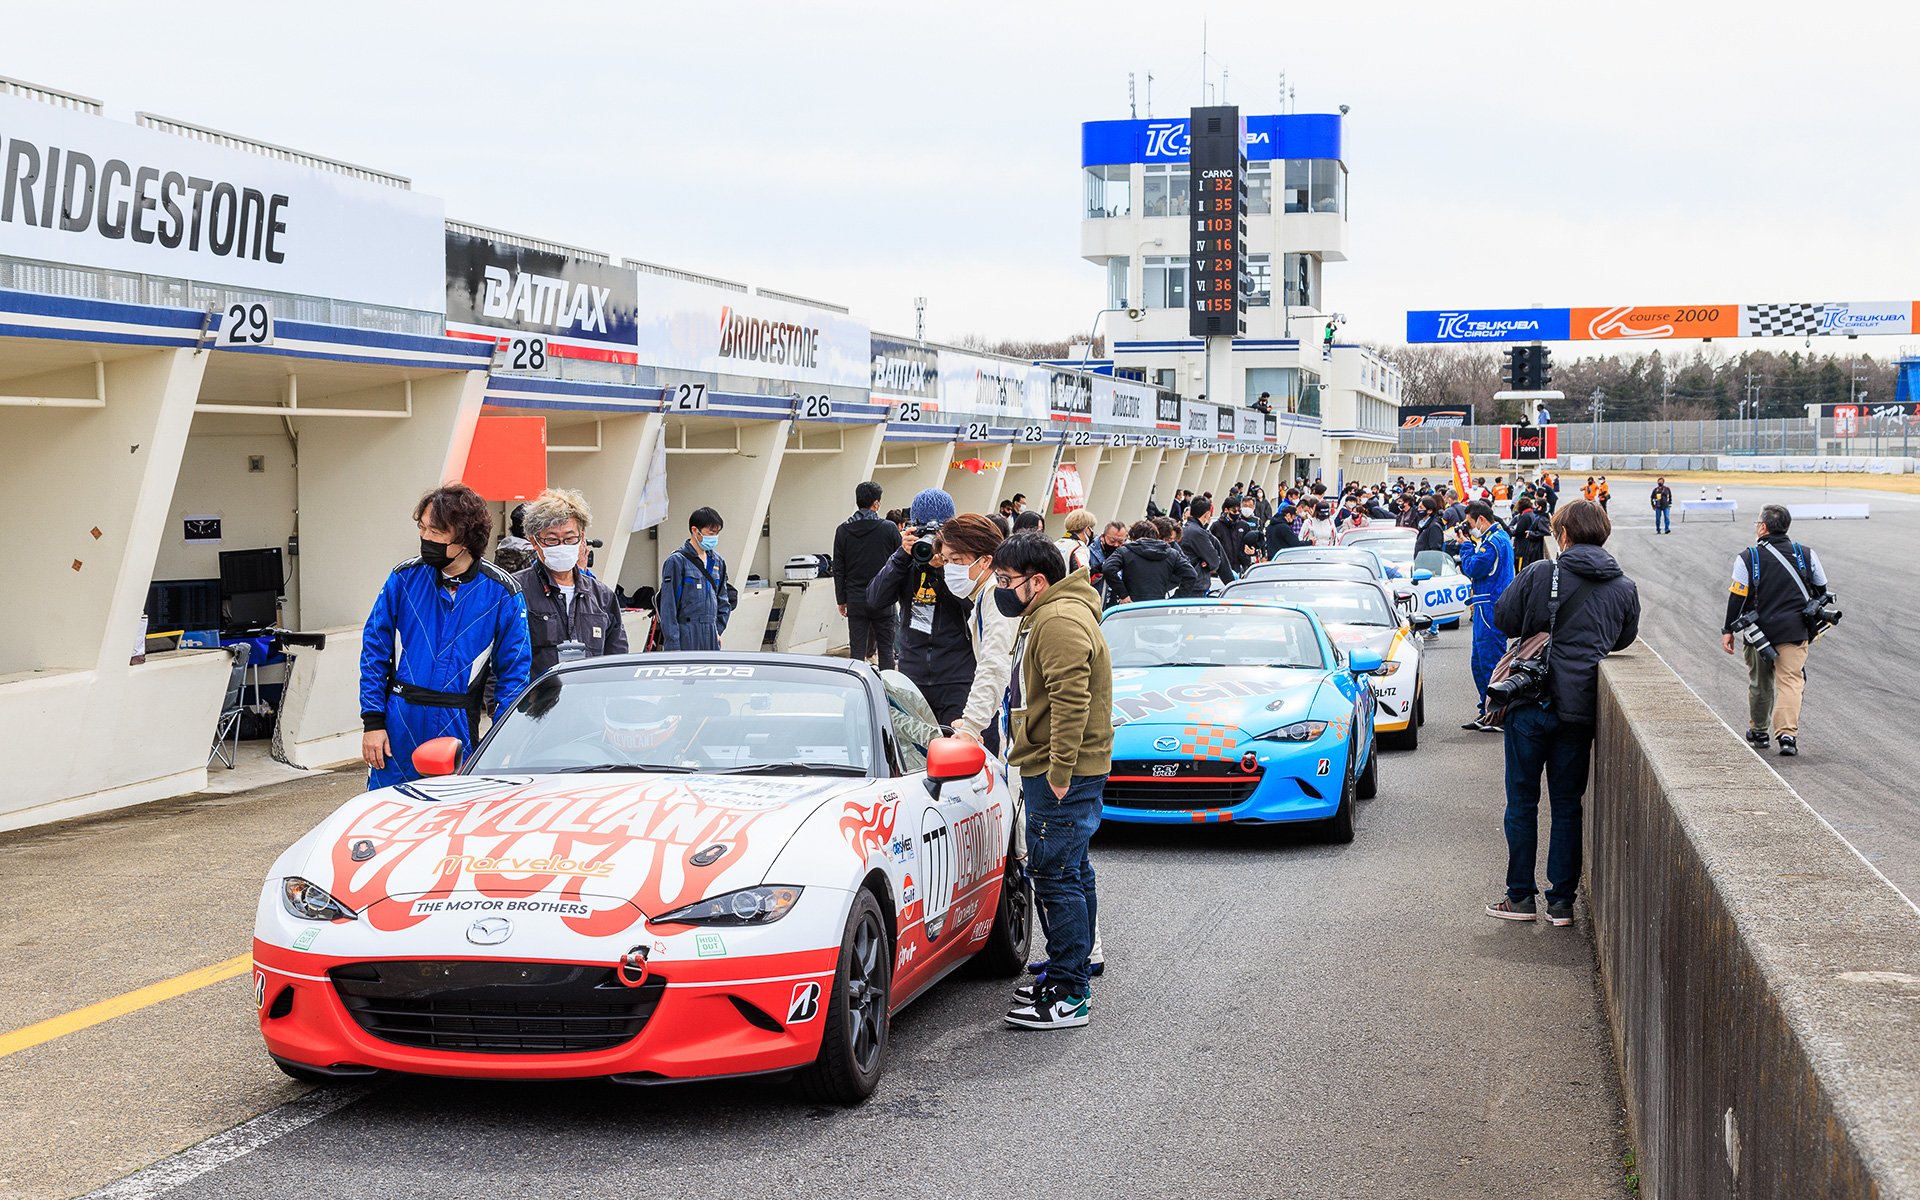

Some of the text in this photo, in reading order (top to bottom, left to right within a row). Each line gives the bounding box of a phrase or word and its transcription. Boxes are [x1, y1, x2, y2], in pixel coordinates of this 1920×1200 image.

[1202, 170, 1219, 178] CAR
[1216, 178, 1232, 191] 32
[0, 137, 290, 265] RIDGESTONE
[1216, 198, 1232, 211] 35
[1208, 218, 1232, 232] 103
[1216, 238, 1232, 251] 16
[1215, 258, 1232, 271] 29
[1215, 278, 1232, 291] 36
[482, 264, 611, 334] BATTLAX
[1208, 298, 1232, 312] 155
[1630, 308, 1719, 322] course 2000
[228, 303, 268, 343] 29
[1467, 320, 1539, 330] TSUKUBA
[718, 305, 819, 370] BRIDGESTONE
[512, 338, 545, 371] 28
[874, 354, 927, 392] BATTLAX
[678, 383, 706, 410] 27
[806, 394, 830, 417] 26
[900, 402, 920, 422] 25
[969, 423, 988, 440] 24
[1025, 426, 1042, 442] 23
[1075, 432, 1090, 446] 22
[1113, 434, 1127, 447] 21
[1146, 435, 1158, 446] 20
[1174, 438, 1184, 448] 19
[1198, 438, 1208, 448] 18
[1216, 443, 1226, 452] 17
[1236, 444, 1246, 452] 16
[1252, 444, 1261, 454] 15
[1266, 445, 1274, 454] 14
[1280, 446, 1288, 454] 12
[1424, 588, 1454, 608] CAR
[612, 732, 655, 748] LEVOLANT
[346, 799, 749, 843] LEVOLANT
[922, 826, 949, 916] 777
[416, 901, 588, 914] THE MOTOR BROTHERS
